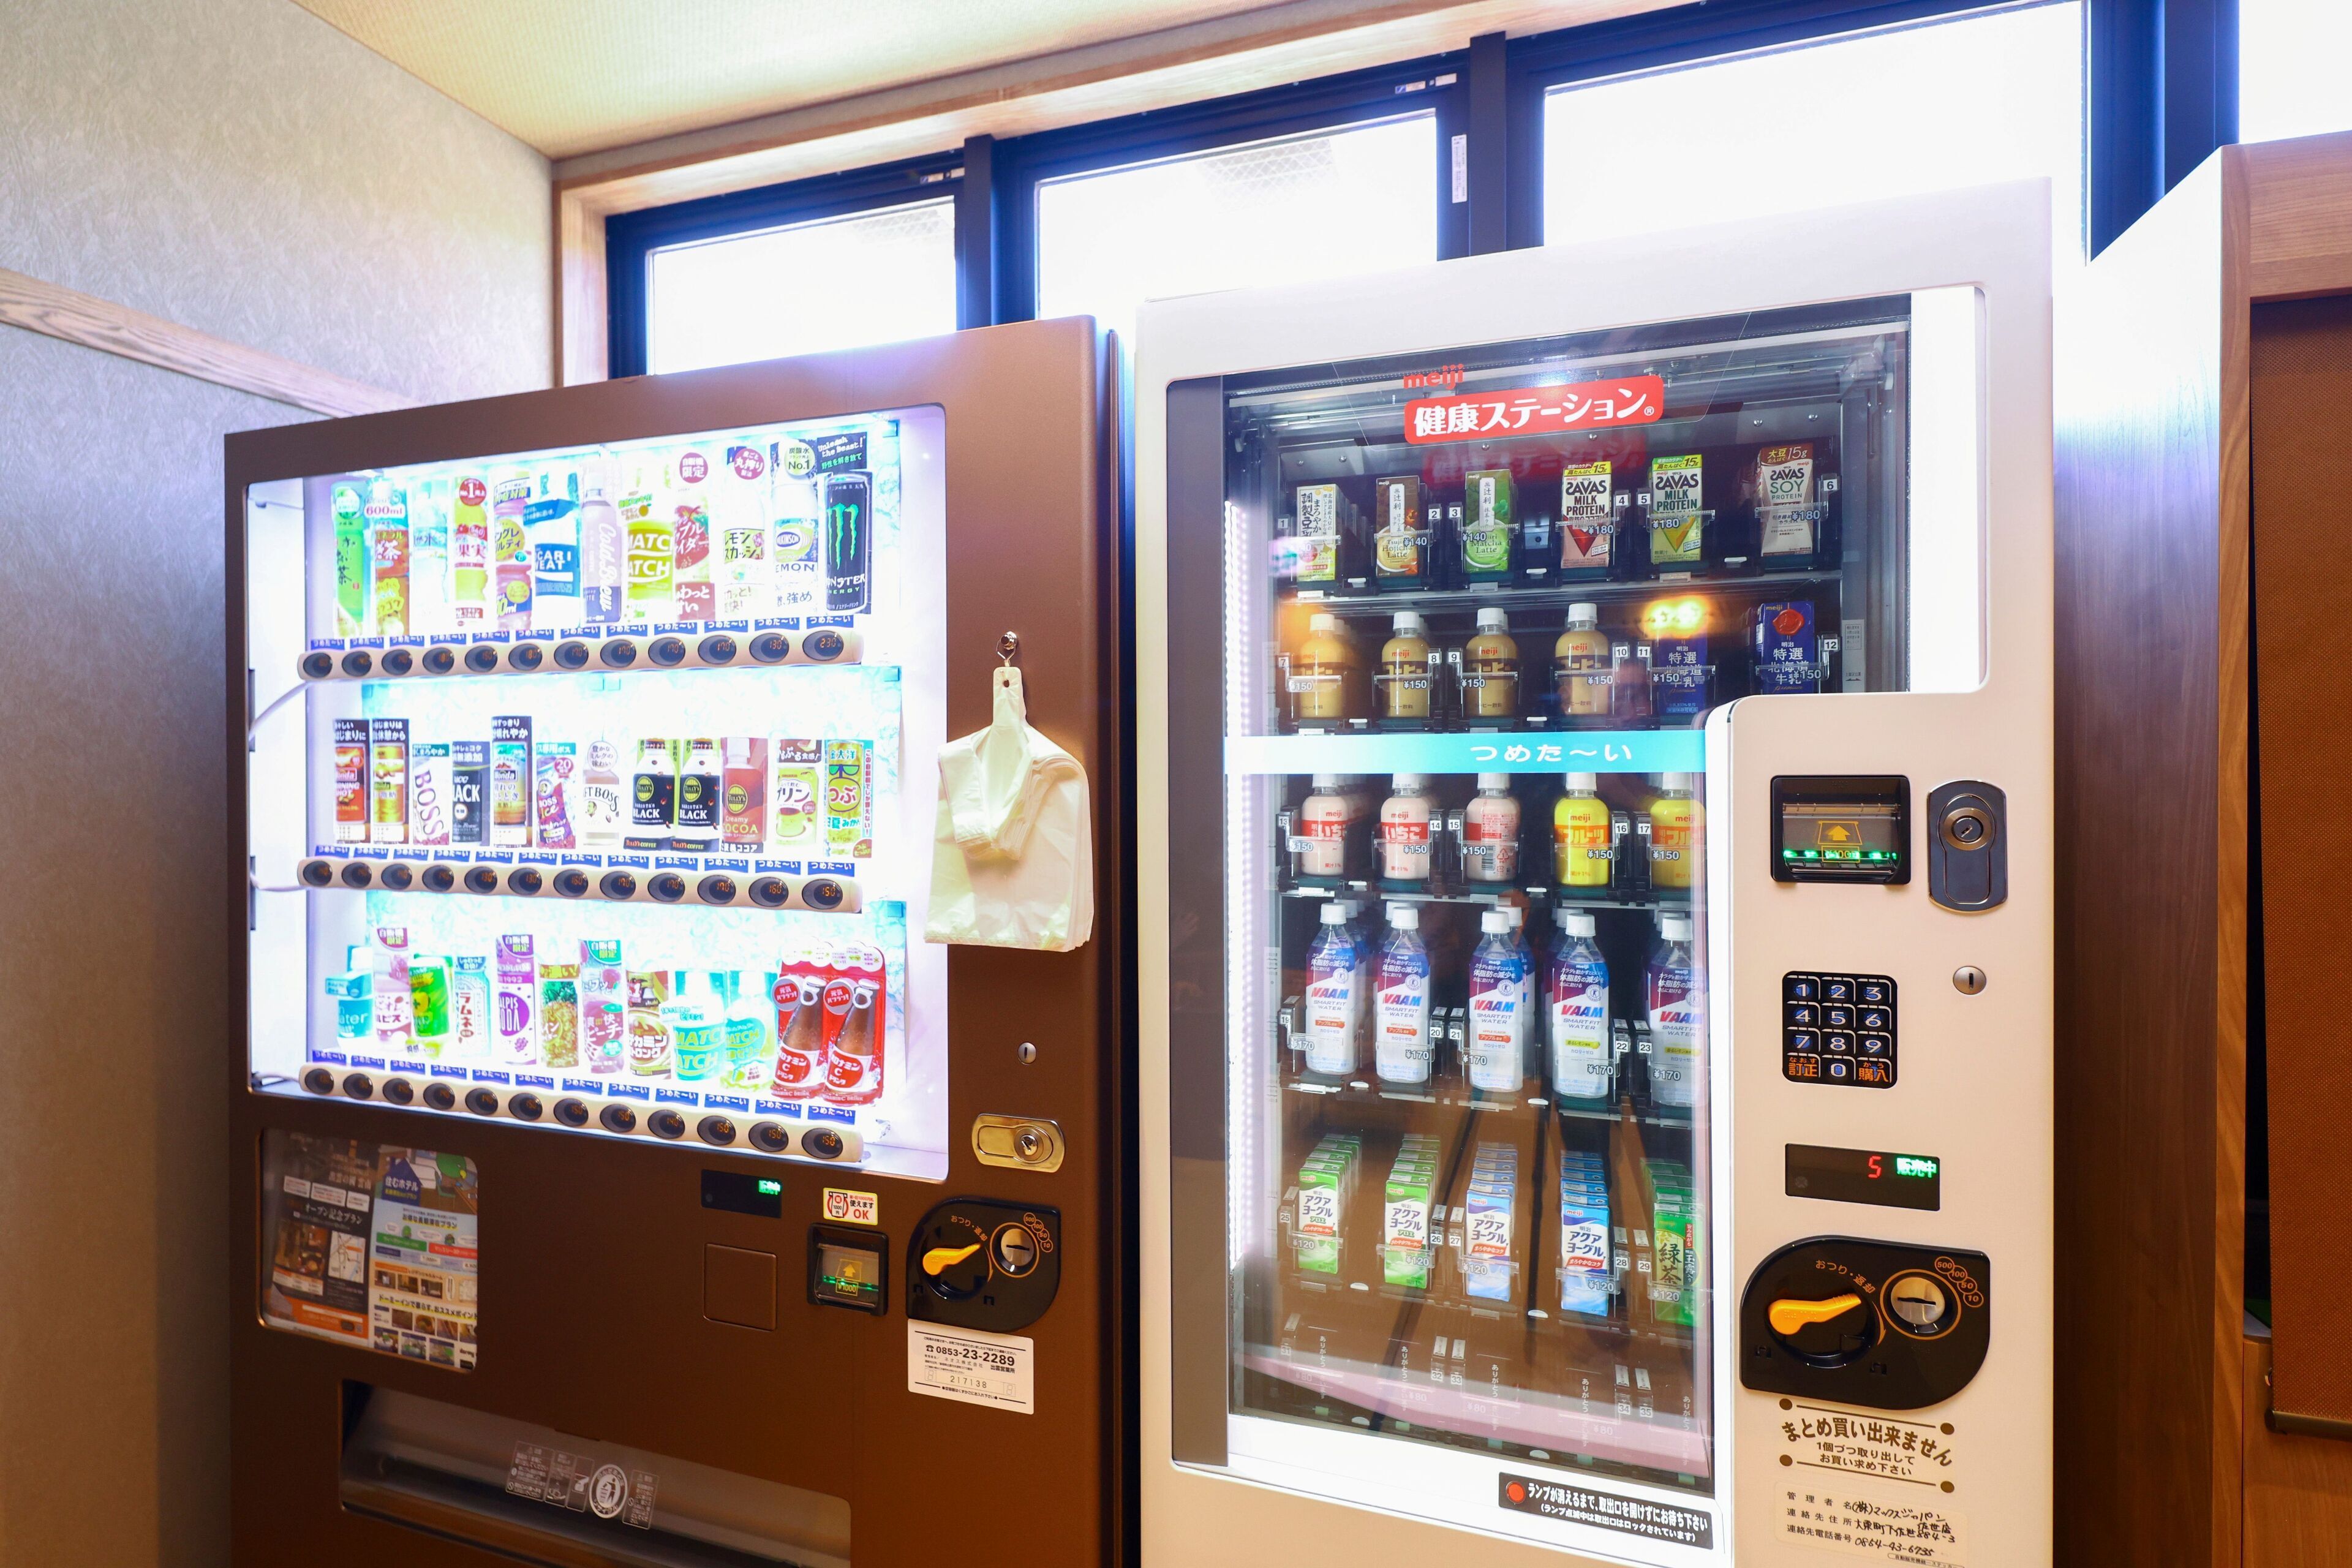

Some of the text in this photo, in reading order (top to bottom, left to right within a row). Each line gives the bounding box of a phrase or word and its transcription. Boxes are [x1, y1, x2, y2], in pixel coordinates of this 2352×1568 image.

[1403, 363, 1464, 390] meiji
[1766, 448, 1788, 459] 大豆
[788, 461, 810, 470] No.1
[1770, 467, 1804, 481] SAVAS
[1566, 480, 1607, 496] SAVAS
[1655, 473, 1699, 491] SAVAS
[1770, 479, 1804, 494] SOY
[1826, 481, 1834, 490] 6
[1574, 495, 1597, 506] MILK
[1664, 489, 1689, 500] MILK
[1566, 504, 1605, 516] PROTEIN
[1656, 499, 1698, 511] PROTEIN
[1791, 510, 1820, 521] ¥180
[1588, 525, 1615, 535] ¥180
[1653, 519, 1679, 529] ¥180
[1403, 537, 1427, 548] ¥140
[1462, 532, 1487, 542] ¥140
[821, 638, 836, 648] 230
[1825, 641, 1837, 649] 12
[1668, 651, 1697, 665] 特選
[1773, 647, 1804, 661] 特選
[413, 768, 445, 836] BOSS
[632, 809, 660, 818] BLACK
[679, 809, 708, 820] BLACK
[1325, 810, 1343, 818] meiji
[1403, 844, 1428, 854] ¥150
[1461, 845, 1487, 856] ¥150
[1587, 849, 1614, 859] ¥150
[1653, 849, 1680, 861] ¥150
[823, 886, 837, 897] 150
[1796, 984, 1806, 997] 1
[1830, 984, 1846, 999] 2
[1866, 986, 1882, 1001] 3
[1383, 993, 1422, 1007] VAAM
[1474, 999, 1516, 1012] VAAM
[459, 991, 473, 1028] ラムネ
[1561, 1005, 1604, 1018] VAAM
[1795, 1009, 1811, 1023] 4
[1831, 1011, 1846, 1025] 5
[1865, 1013, 1882, 1027] 6
[1796, 1035, 1811, 1049] 7
[1830, 1037, 1846, 1051] 8
[1865, 1039, 1882, 1053] 9
[1405, 1049, 1430, 1060] ¥170
[1461, 1054, 1488, 1065] ¥170
[834, 1067, 843, 1076] C
[1587, 1064, 1615, 1076] ¥170
[1653, 1069, 1681, 1081] ¥170
[1788, 1063, 1818, 1077] 訂正
[1830, 1063, 1847, 1078] 0
[1858, 1068, 1889, 1082] 購入
[823, 1136, 835, 1146] 150
[850, 1199, 874, 1209] 使えます
[1305, 1195, 1332, 1206] アクア
[853, 1208, 870, 1220] OK
[1392, 1208, 1421, 1218] アクア
[1473, 1219, 1505, 1231] アクア
[1450, 1237, 1460, 1245] 27
[1569, 1232, 1603, 1244] アクア
[1405, 1255, 1430, 1267] ¥120
[1616, 1258, 1627, 1267] 28
[1639, 1262, 1650, 1271] 29
[1658, 1242, 1683, 1285] 緑茶
[1937, 1261, 1953, 1269] 500
[1463, 1262, 1488, 1275] ¥120
[1951, 1270, 1966, 1278] 100
[1588, 1279, 1615, 1292] ¥120
[1653, 1289, 1680, 1302] ¥120
[936, 1345, 1016, 1366] 0853-23-2289
[990, 1363, 1016, 1374] 出雲営業所
[950, 1374, 987, 1389] 217138
[1619, 1404, 1630, 1413] 34
[1641, 1408, 1652, 1416] 35
[1781, 1417, 1953, 1468] まとめ買い出来ません
[1819, 1453, 1913, 1476] お買い求め下さい
[1787, 1524, 1852, 1544] 連絡先電話番号
